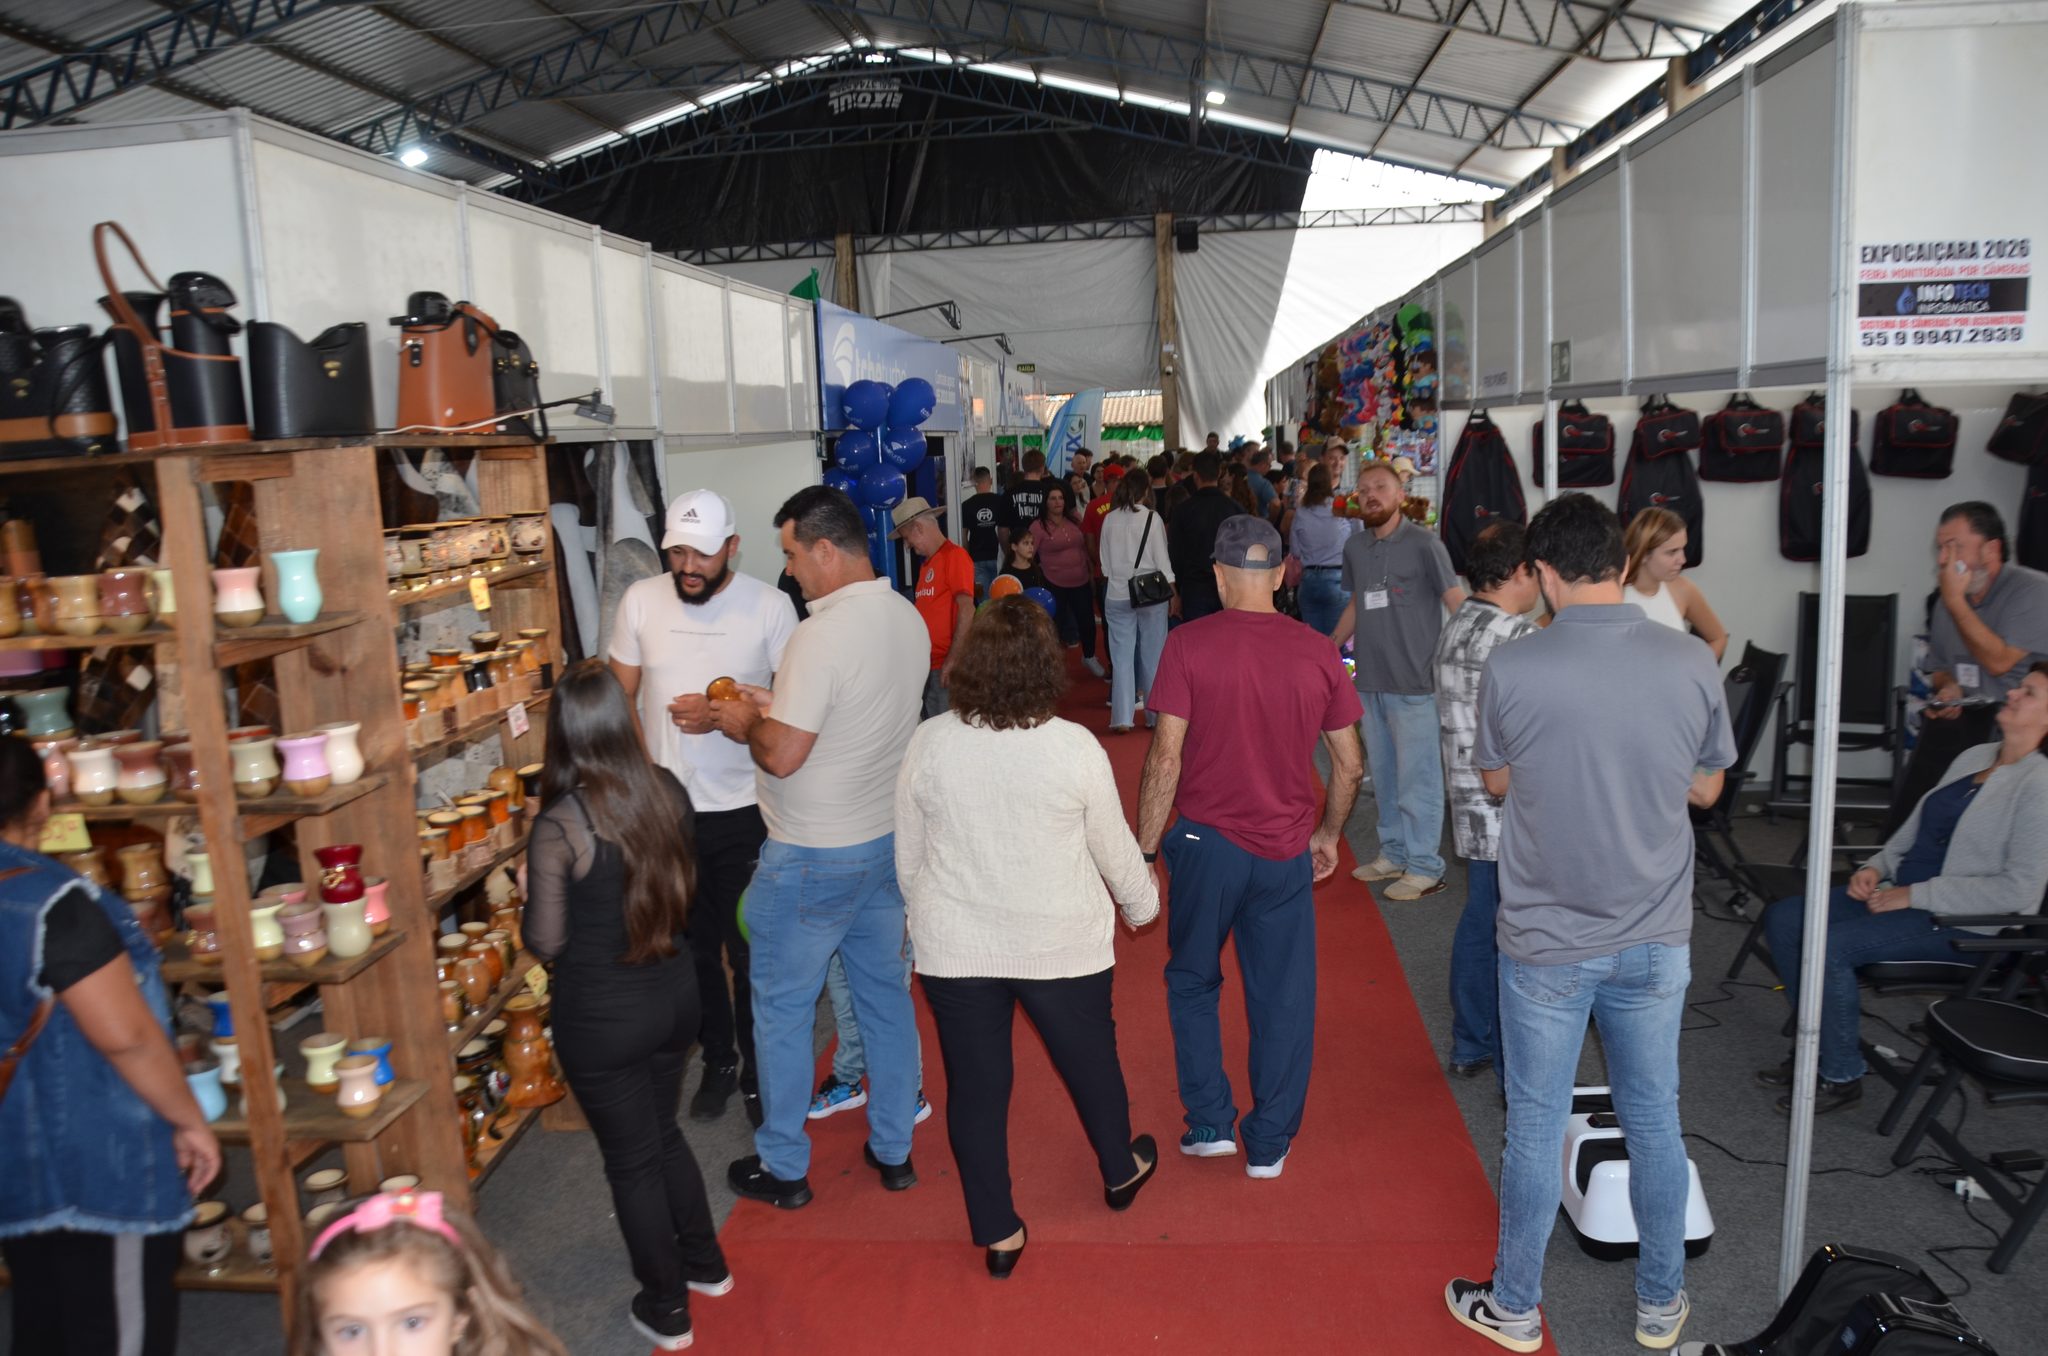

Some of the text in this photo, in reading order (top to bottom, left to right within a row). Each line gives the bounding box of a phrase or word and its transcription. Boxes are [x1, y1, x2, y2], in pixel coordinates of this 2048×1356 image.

[1861, 239, 2030, 264] EXPOCAIÇARA 2026
[1861, 331, 1888, 347] 55
